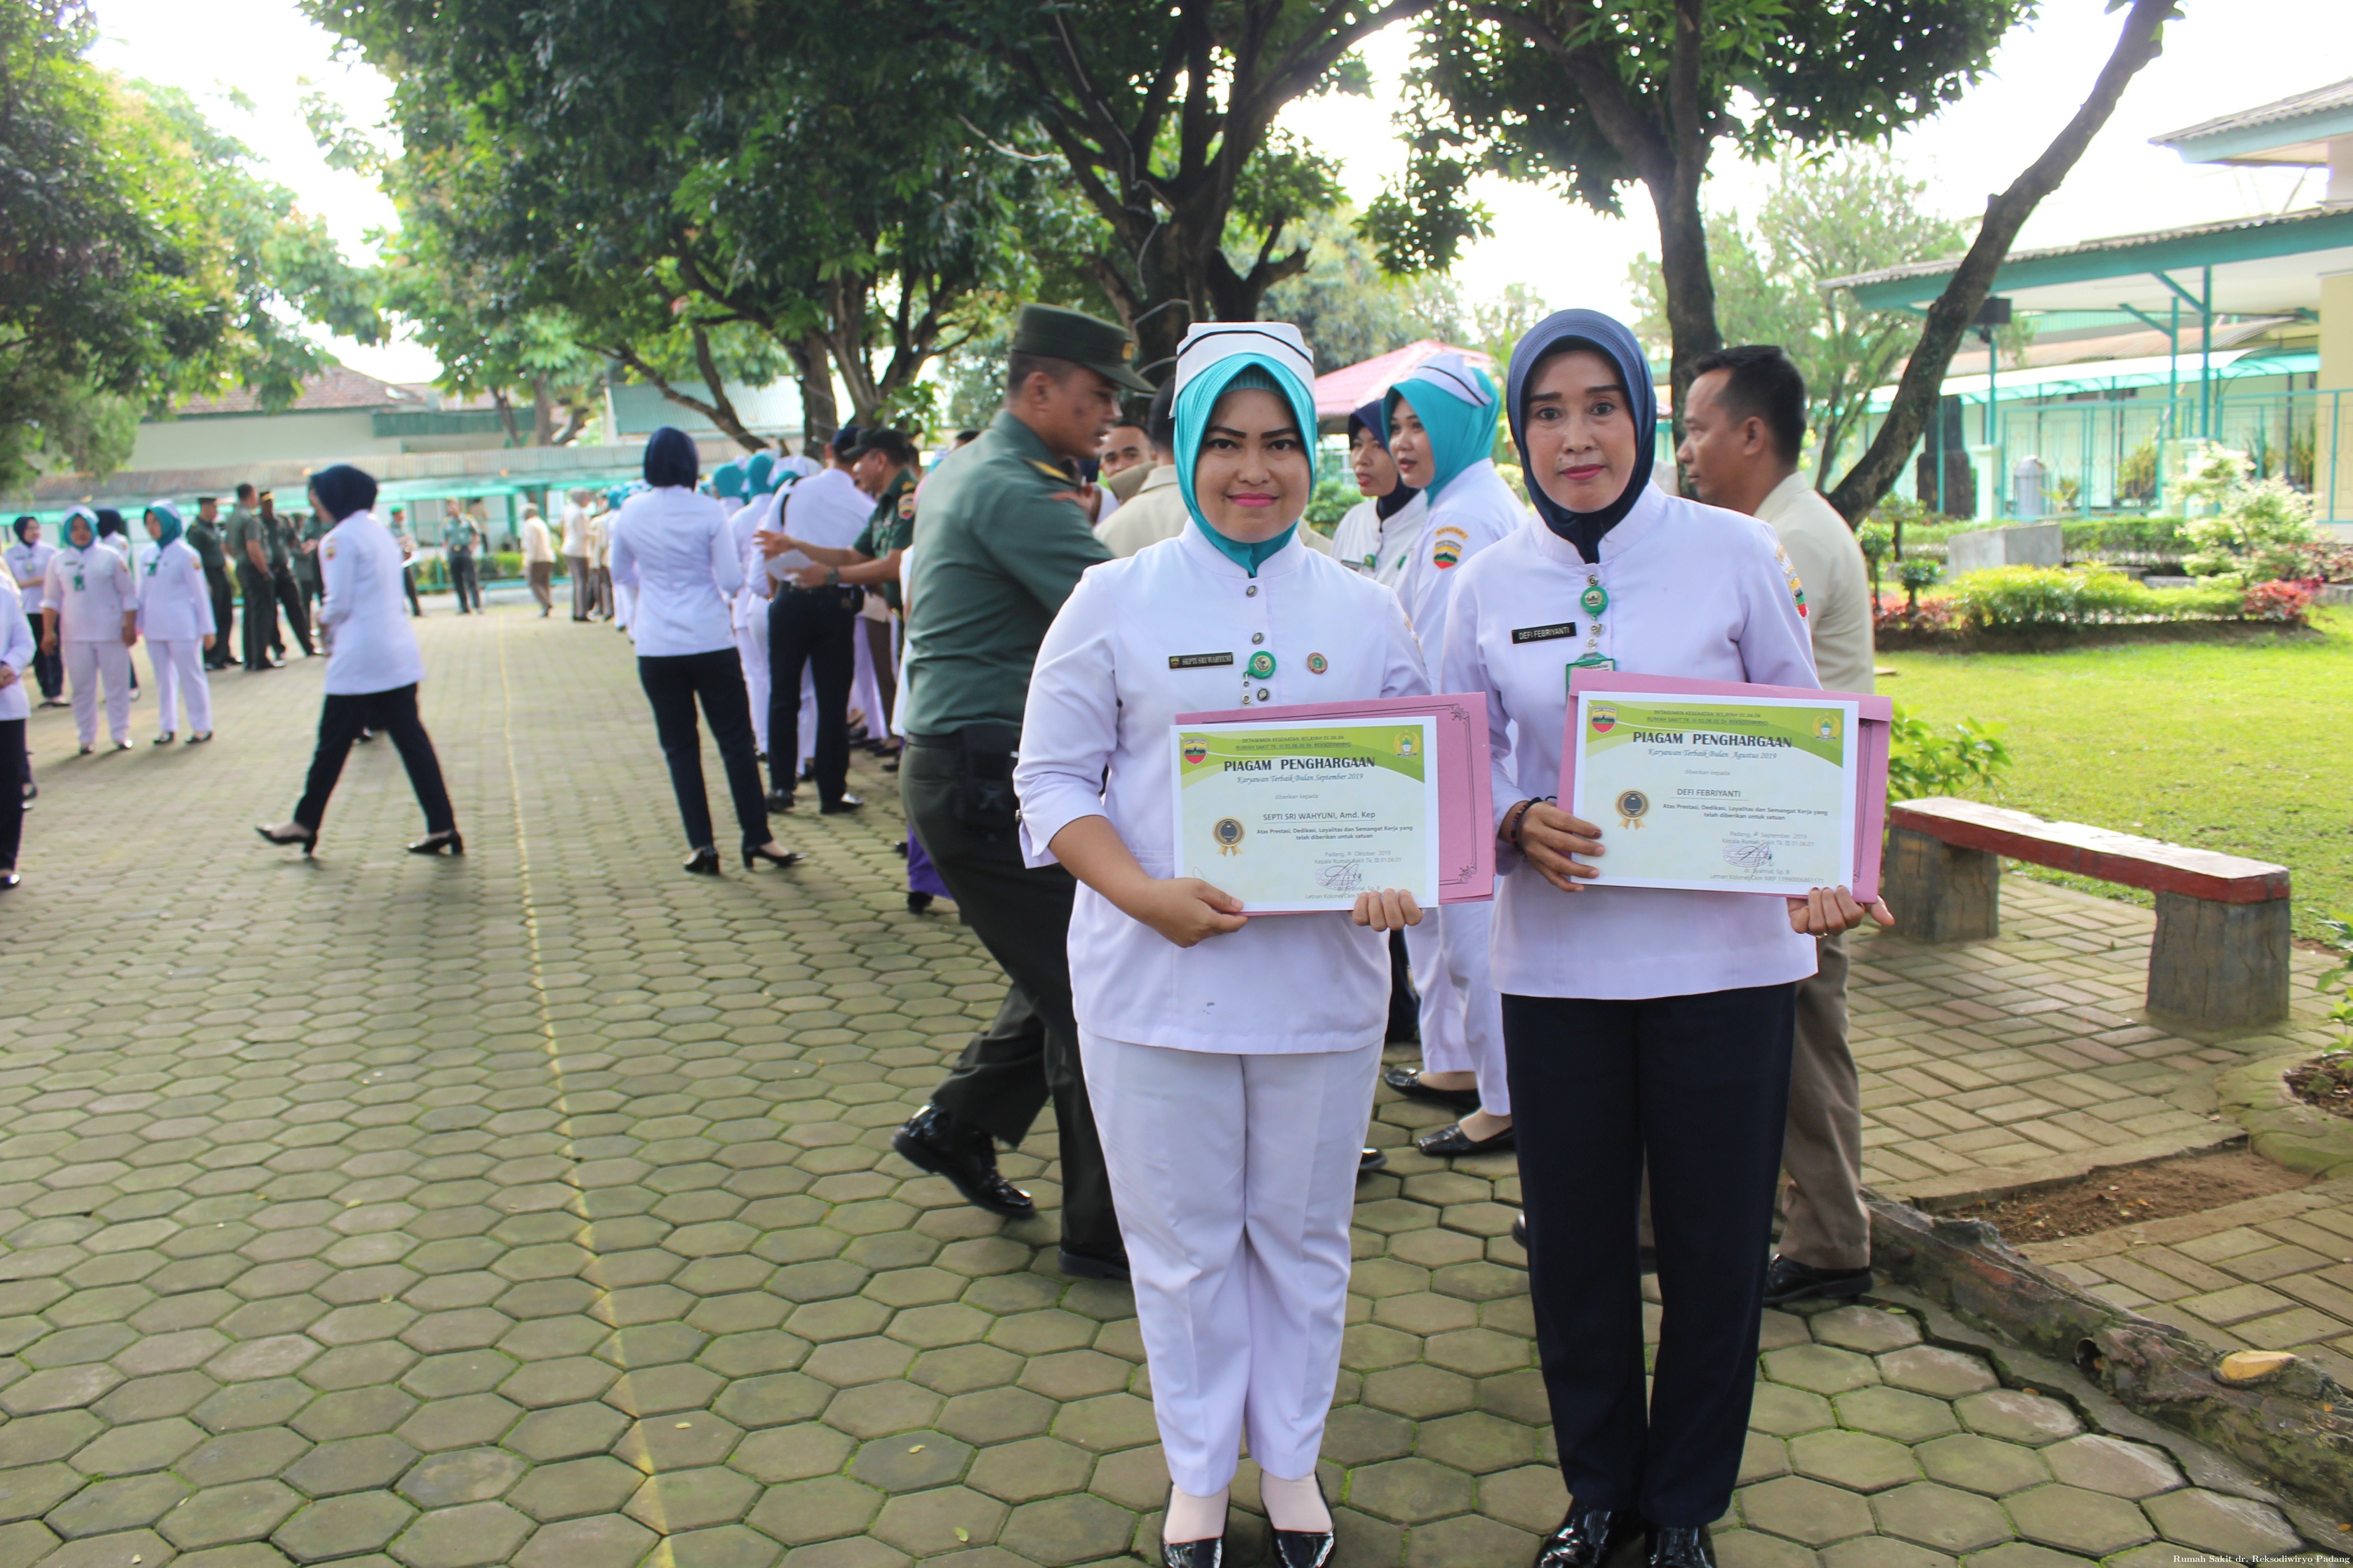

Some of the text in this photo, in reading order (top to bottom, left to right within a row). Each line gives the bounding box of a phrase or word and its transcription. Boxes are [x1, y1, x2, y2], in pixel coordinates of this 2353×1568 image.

[1519, 627, 1570, 640] DEFI FEBRIYANTI
[1633, 731, 1792, 748] PIAGAM PENGHARGAAN
[1733, 751, 1759, 760] Agustus
[1224, 757, 1376, 771] PIAGAM PENGHARGAAN
[1237, 776, 1269, 785] Karyawan
[1315, 774, 1346, 782] September
[1696, 789, 1741, 797] FEBRIYANTI
